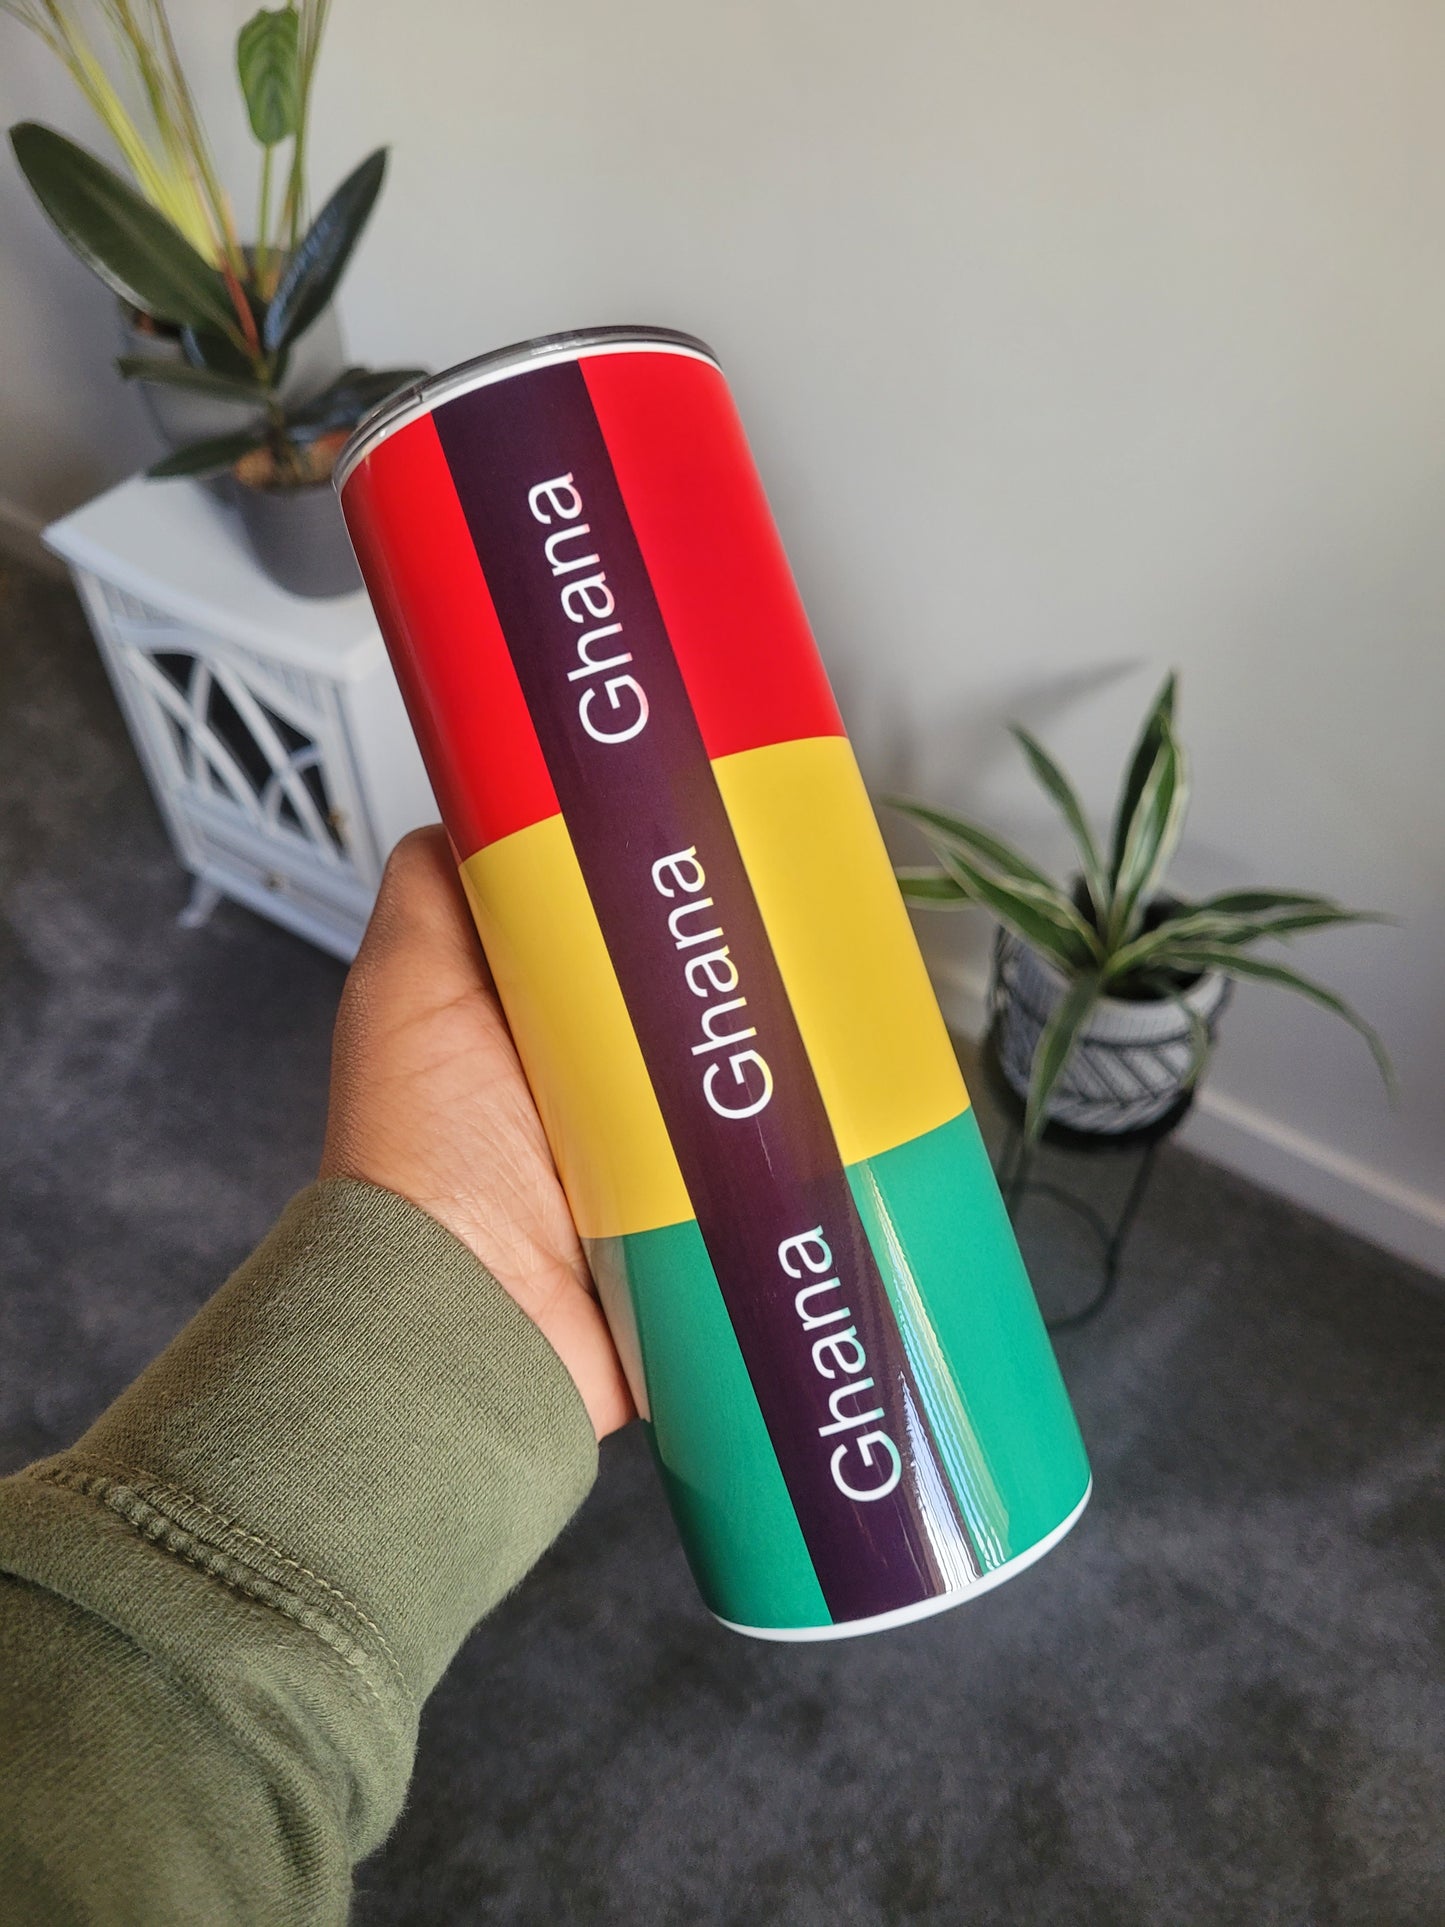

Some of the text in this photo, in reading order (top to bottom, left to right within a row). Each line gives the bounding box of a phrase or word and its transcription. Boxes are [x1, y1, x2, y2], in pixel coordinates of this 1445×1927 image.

[528, 472, 650, 744] Ghana
[651, 845, 774, 1120] Ghana
[777, 1225, 902, 1502] Ghana
